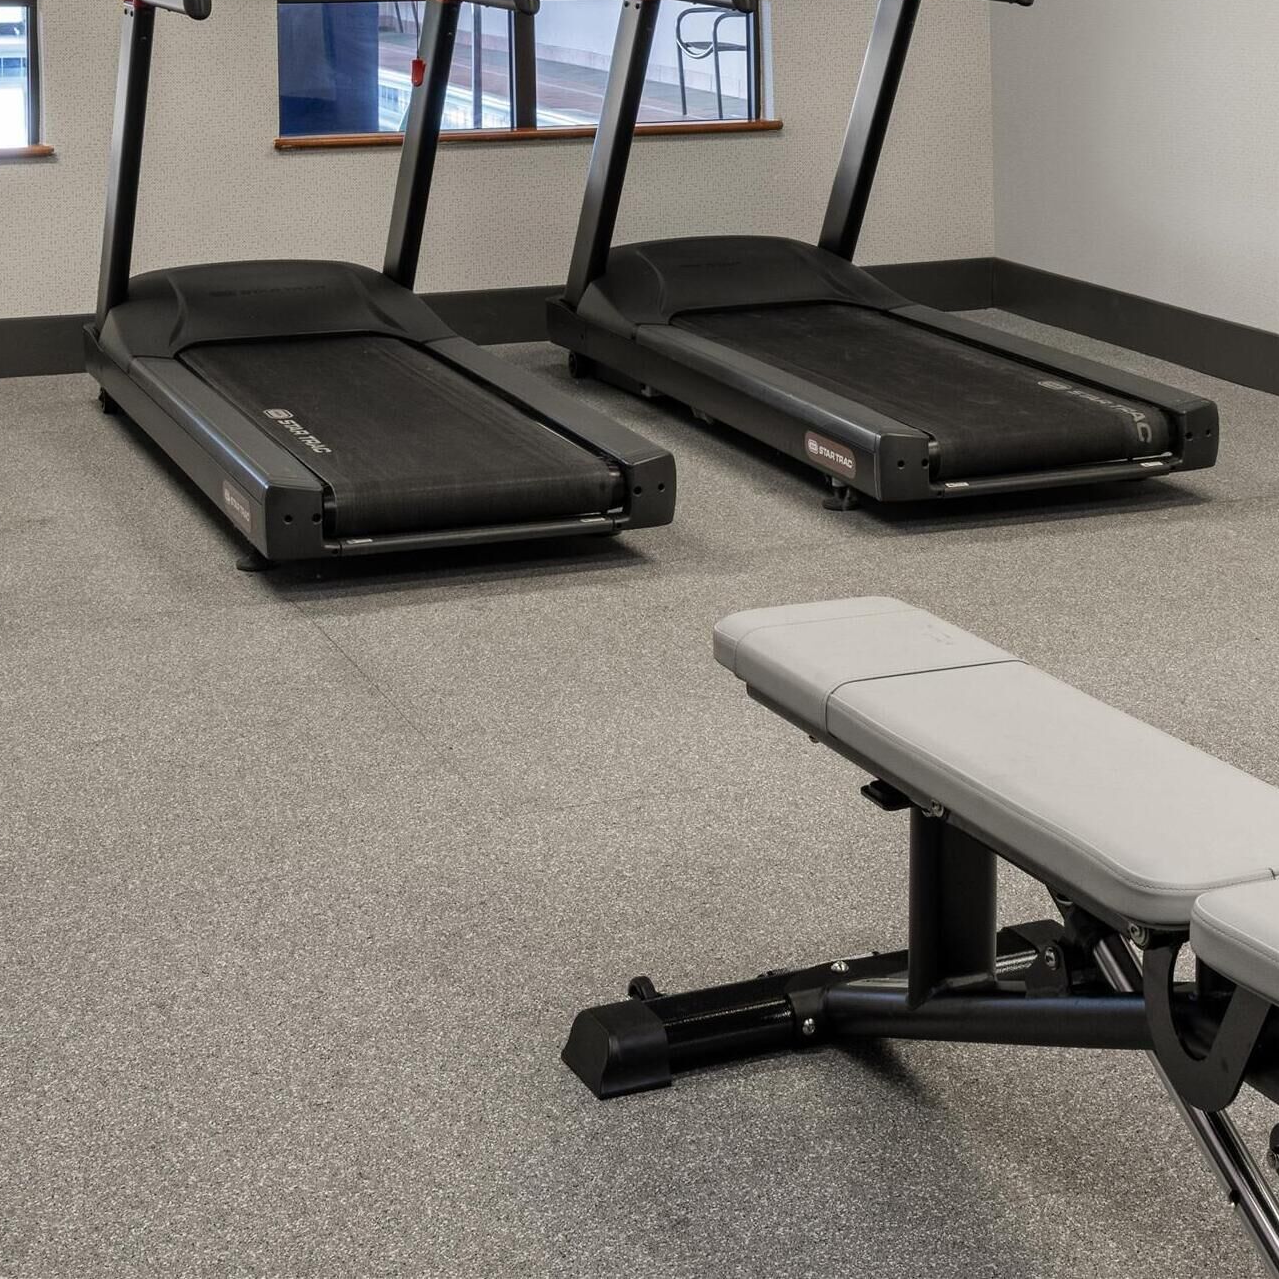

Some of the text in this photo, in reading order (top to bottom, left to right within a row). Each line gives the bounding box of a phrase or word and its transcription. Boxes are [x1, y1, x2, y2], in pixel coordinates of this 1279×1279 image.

[277, 419, 332, 454] STAR TRAC
[819, 446, 853, 469] STAR TRAC
